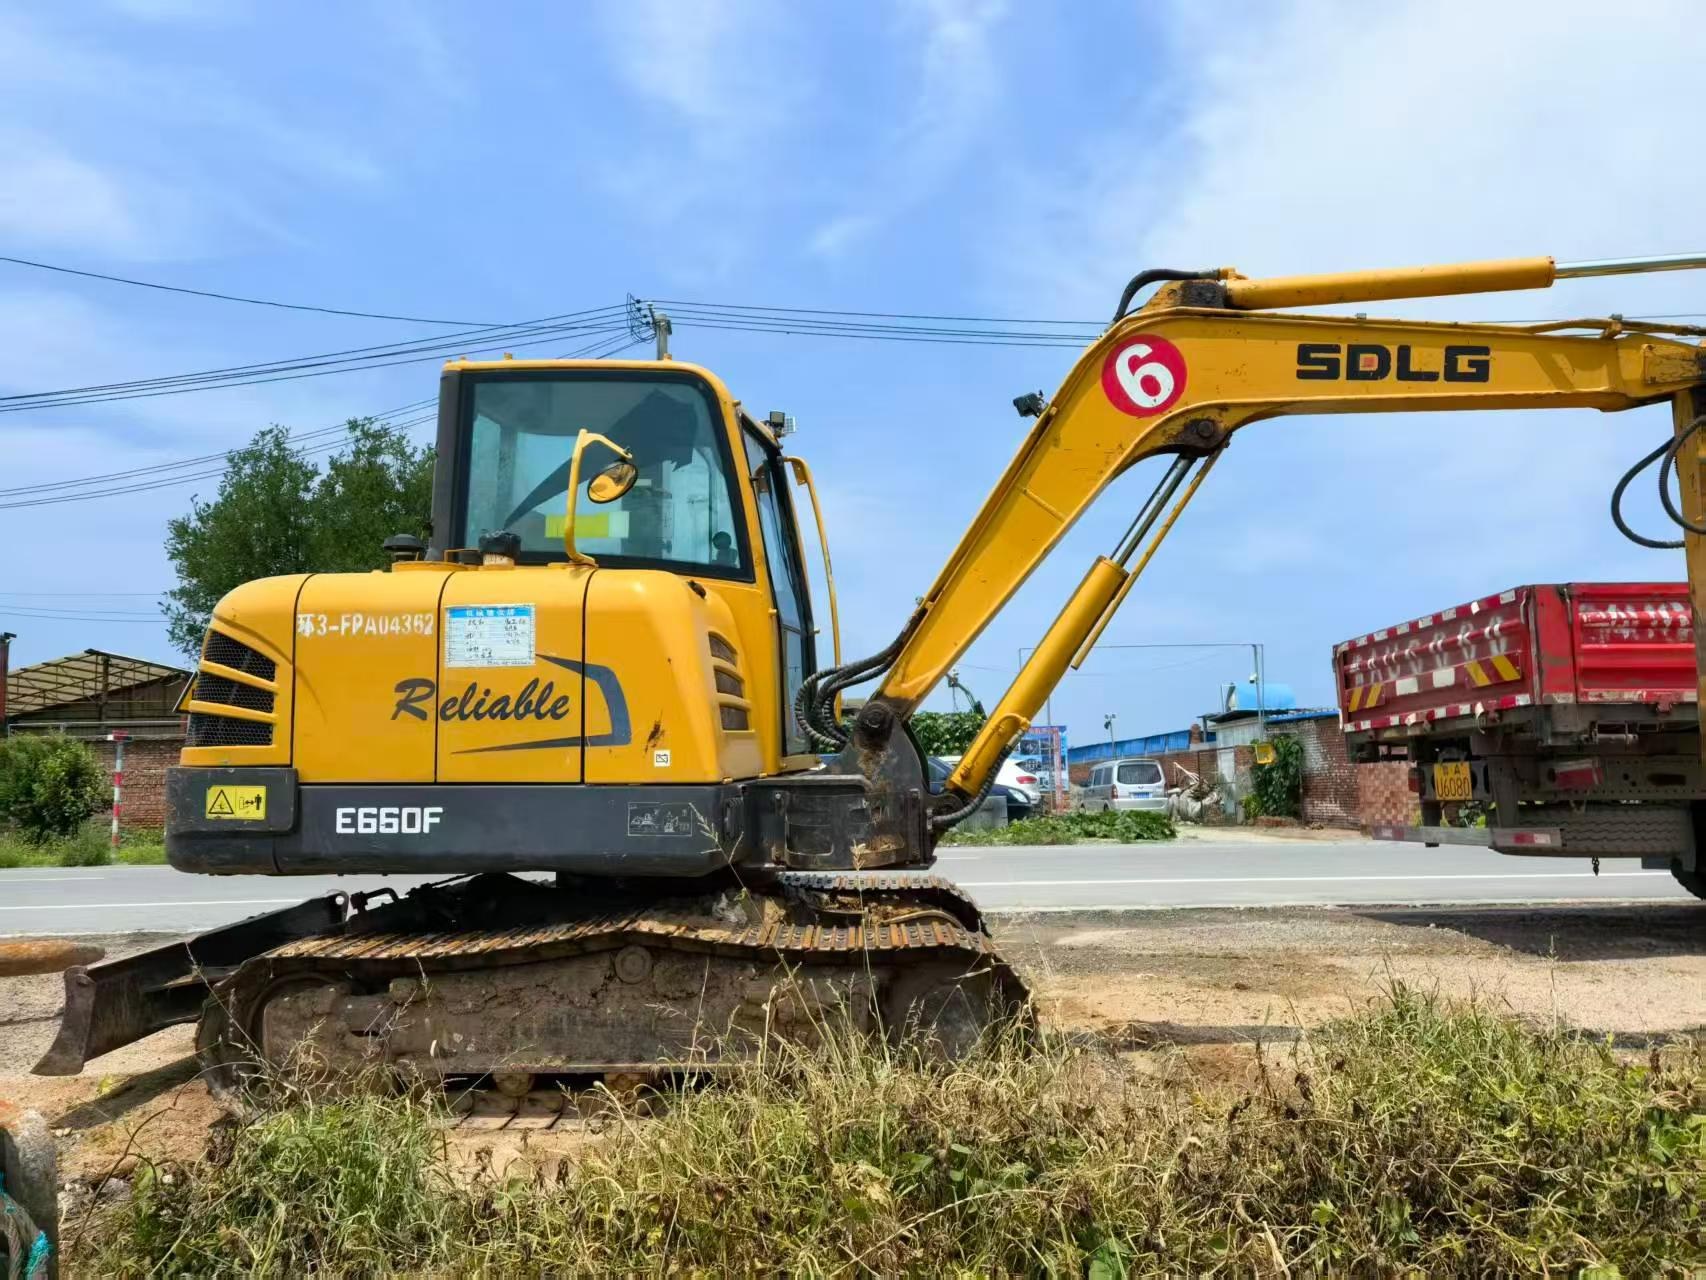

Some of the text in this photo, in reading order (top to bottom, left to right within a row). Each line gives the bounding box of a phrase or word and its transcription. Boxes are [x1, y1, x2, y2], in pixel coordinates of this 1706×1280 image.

[1116, 343, 1175, 408] 6
[1296, 344, 1490, 382] SDLG
[391, 677, 570, 721] Reliable
[335, 807, 444, 834] E660F
